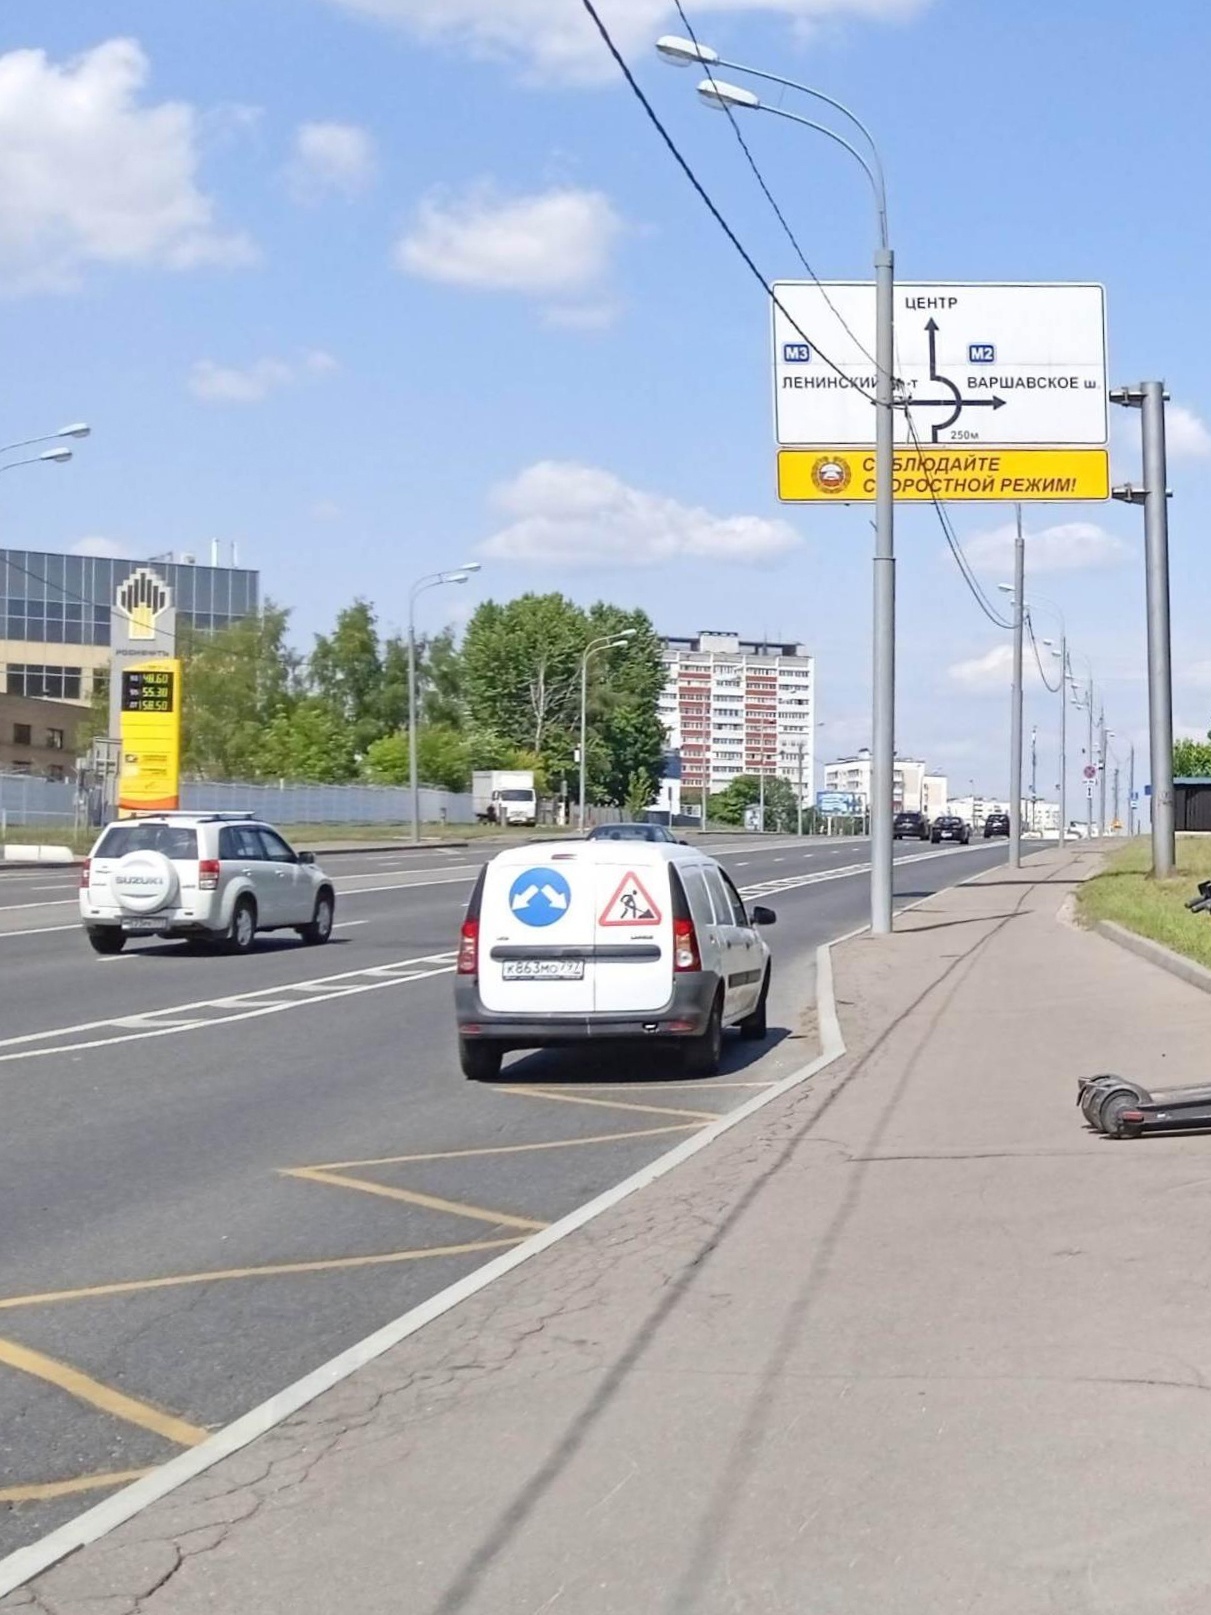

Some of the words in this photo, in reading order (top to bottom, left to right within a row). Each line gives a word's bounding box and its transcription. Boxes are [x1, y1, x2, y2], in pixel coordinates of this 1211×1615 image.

[905, 297, 958, 311] ЦЕНТР
[967, 376, 1079, 390] ВАРШАВСКОЕ
[950, 430, 980, 440] 250м
[862, 454, 1001, 475] СБЛЮДАЙТЕ
[863, 475, 995, 493] СОРОСТНОЙ
[1000, 478, 1077, 493] РЕЖИМ!
[115, 876, 164, 885] SUZUKI
